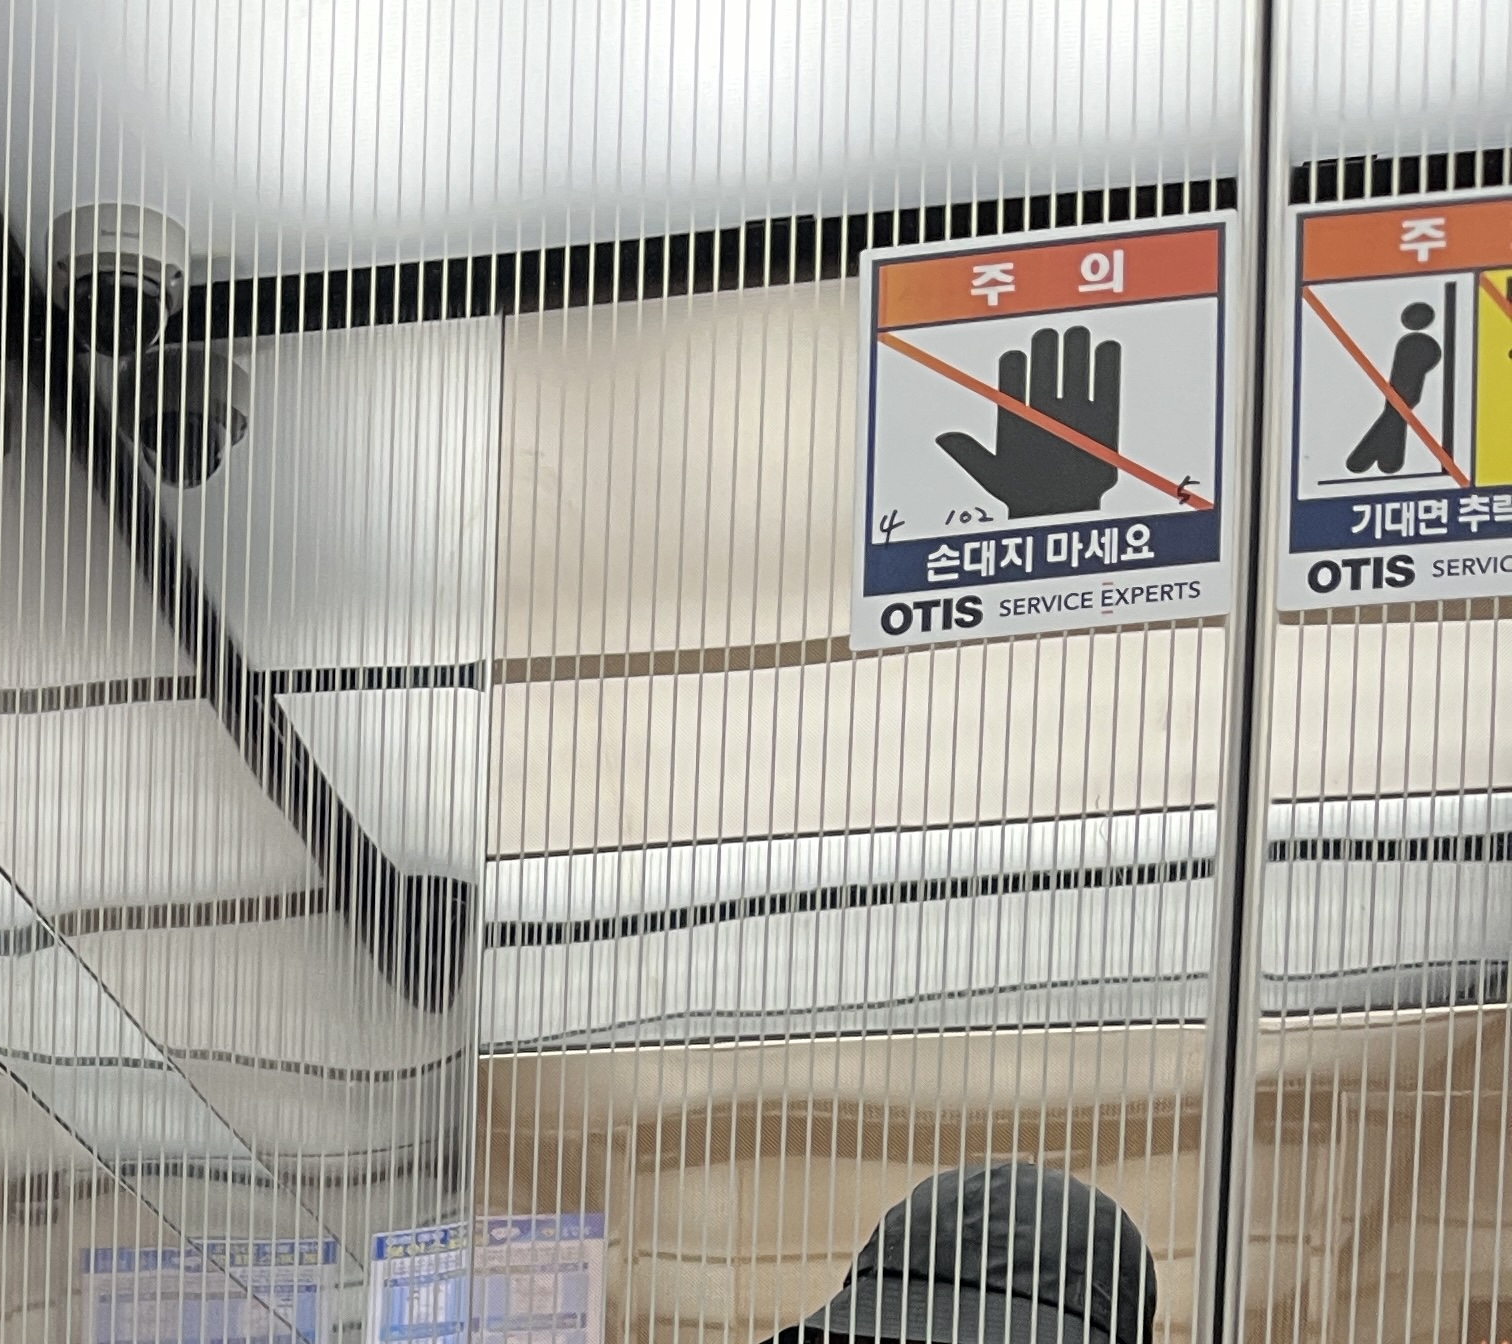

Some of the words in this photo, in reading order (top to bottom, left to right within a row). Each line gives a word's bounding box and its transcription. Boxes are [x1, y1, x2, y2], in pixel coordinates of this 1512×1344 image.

[879, 510, 906, 548] 4
[945, 507, 995, 526] 102
[1351, 498, 1448, 540] 기대면
[926, 536, 1033, 582] 손대지
[1046, 523, 1155, 568] 마세요
[1307, 554, 1416, 594] OTIS
[880, 594, 984, 636] OTIS
[999, 591, 1094, 618] SERVICE
[1101, 580, 1201, 608] EXPERTS
